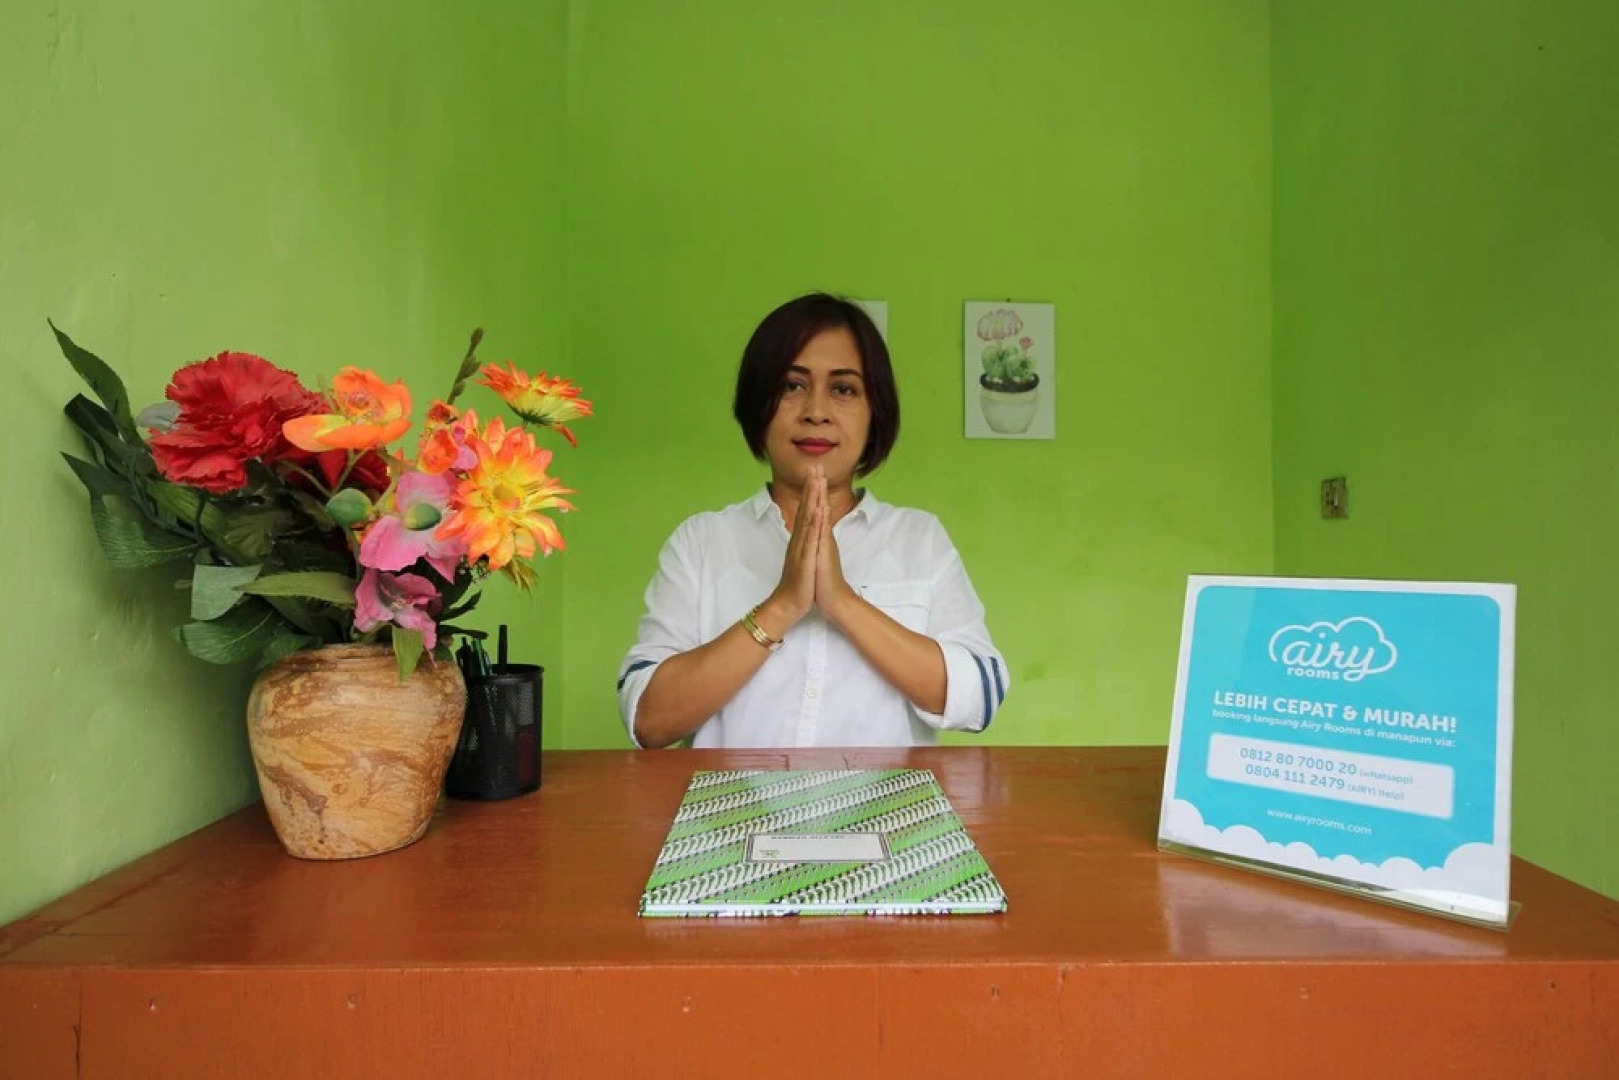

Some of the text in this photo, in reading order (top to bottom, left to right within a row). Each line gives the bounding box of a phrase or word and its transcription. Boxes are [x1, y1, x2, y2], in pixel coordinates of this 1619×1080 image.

[1283, 632, 1376, 682] airy
[1287, 666, 1340, 681] rooms
[1213, 690, 1457, 733] LEBIH CEPAT & MURAH!
[1212, 709, 1251, 723] booking
[1253, 714, 1299, 729] langsung
[1300, 720, 1322, 733] Airy
[1324, 723, 1361, 736] Rooms
[1364, 727, 1375, 737] di
[1377, 731, 1432, 745] manapun
[1240, 747, 1272, 762] 0812
[1276, 751, 1294, 765] 80
[1298, 755, 1334, 771] 7000
[1339, 761, 1357, 775] 20
[1245, 764, 1280, 778] 0804
[1284, 770, 1305, 783] 111
[1309, 774, 1345, 790] 2479
[1267, 808, 1372, 836] www.airyrooms.com
